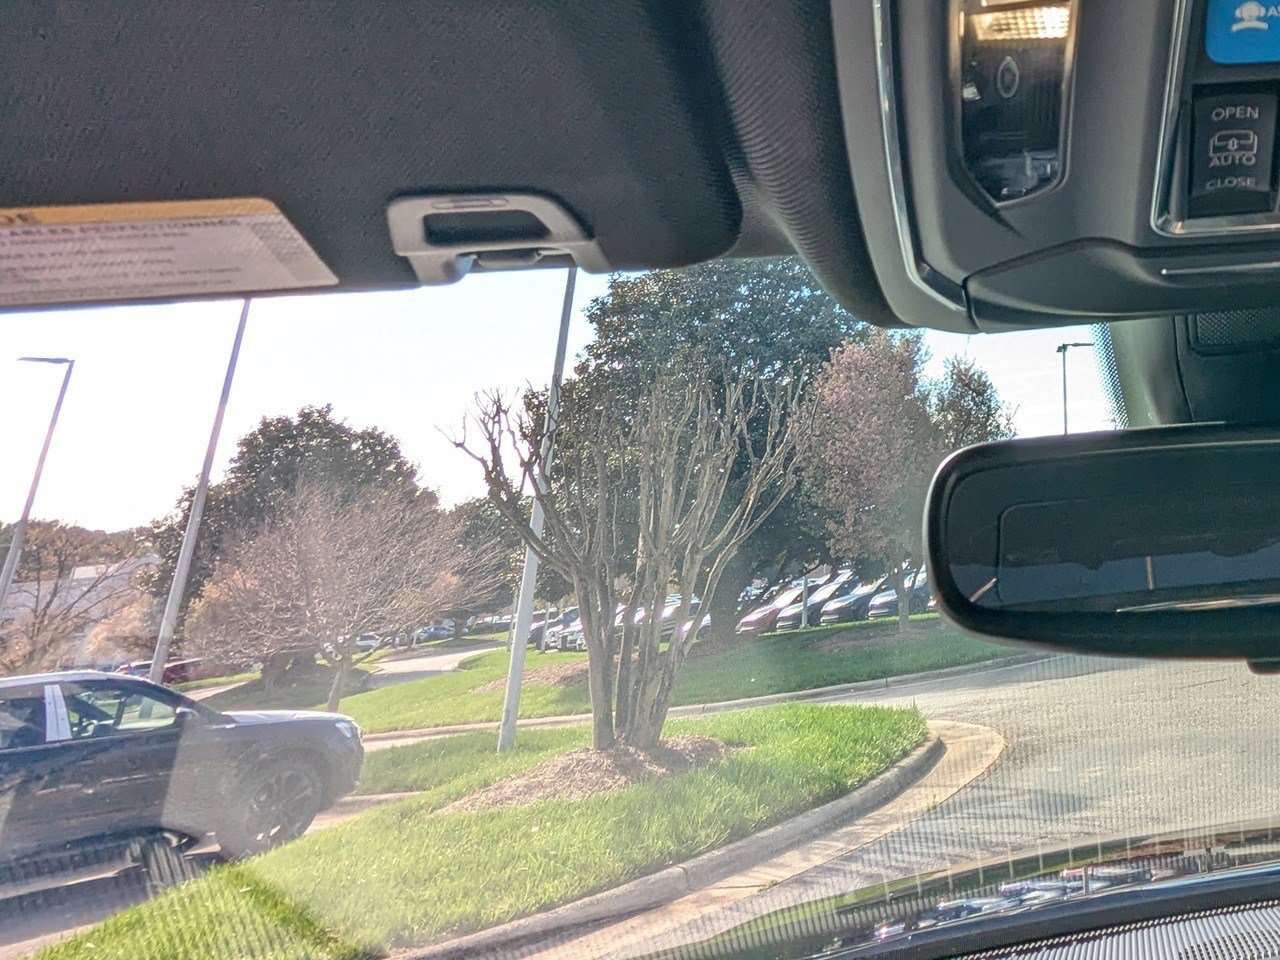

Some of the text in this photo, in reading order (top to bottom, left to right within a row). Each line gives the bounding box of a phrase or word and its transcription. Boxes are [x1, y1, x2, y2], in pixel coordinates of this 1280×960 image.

[1211, 106, 1260, 121] OPEN
[1209, 154, 1256, 168] AUTO
[1206, 176, 1256, 191] CLOSE
